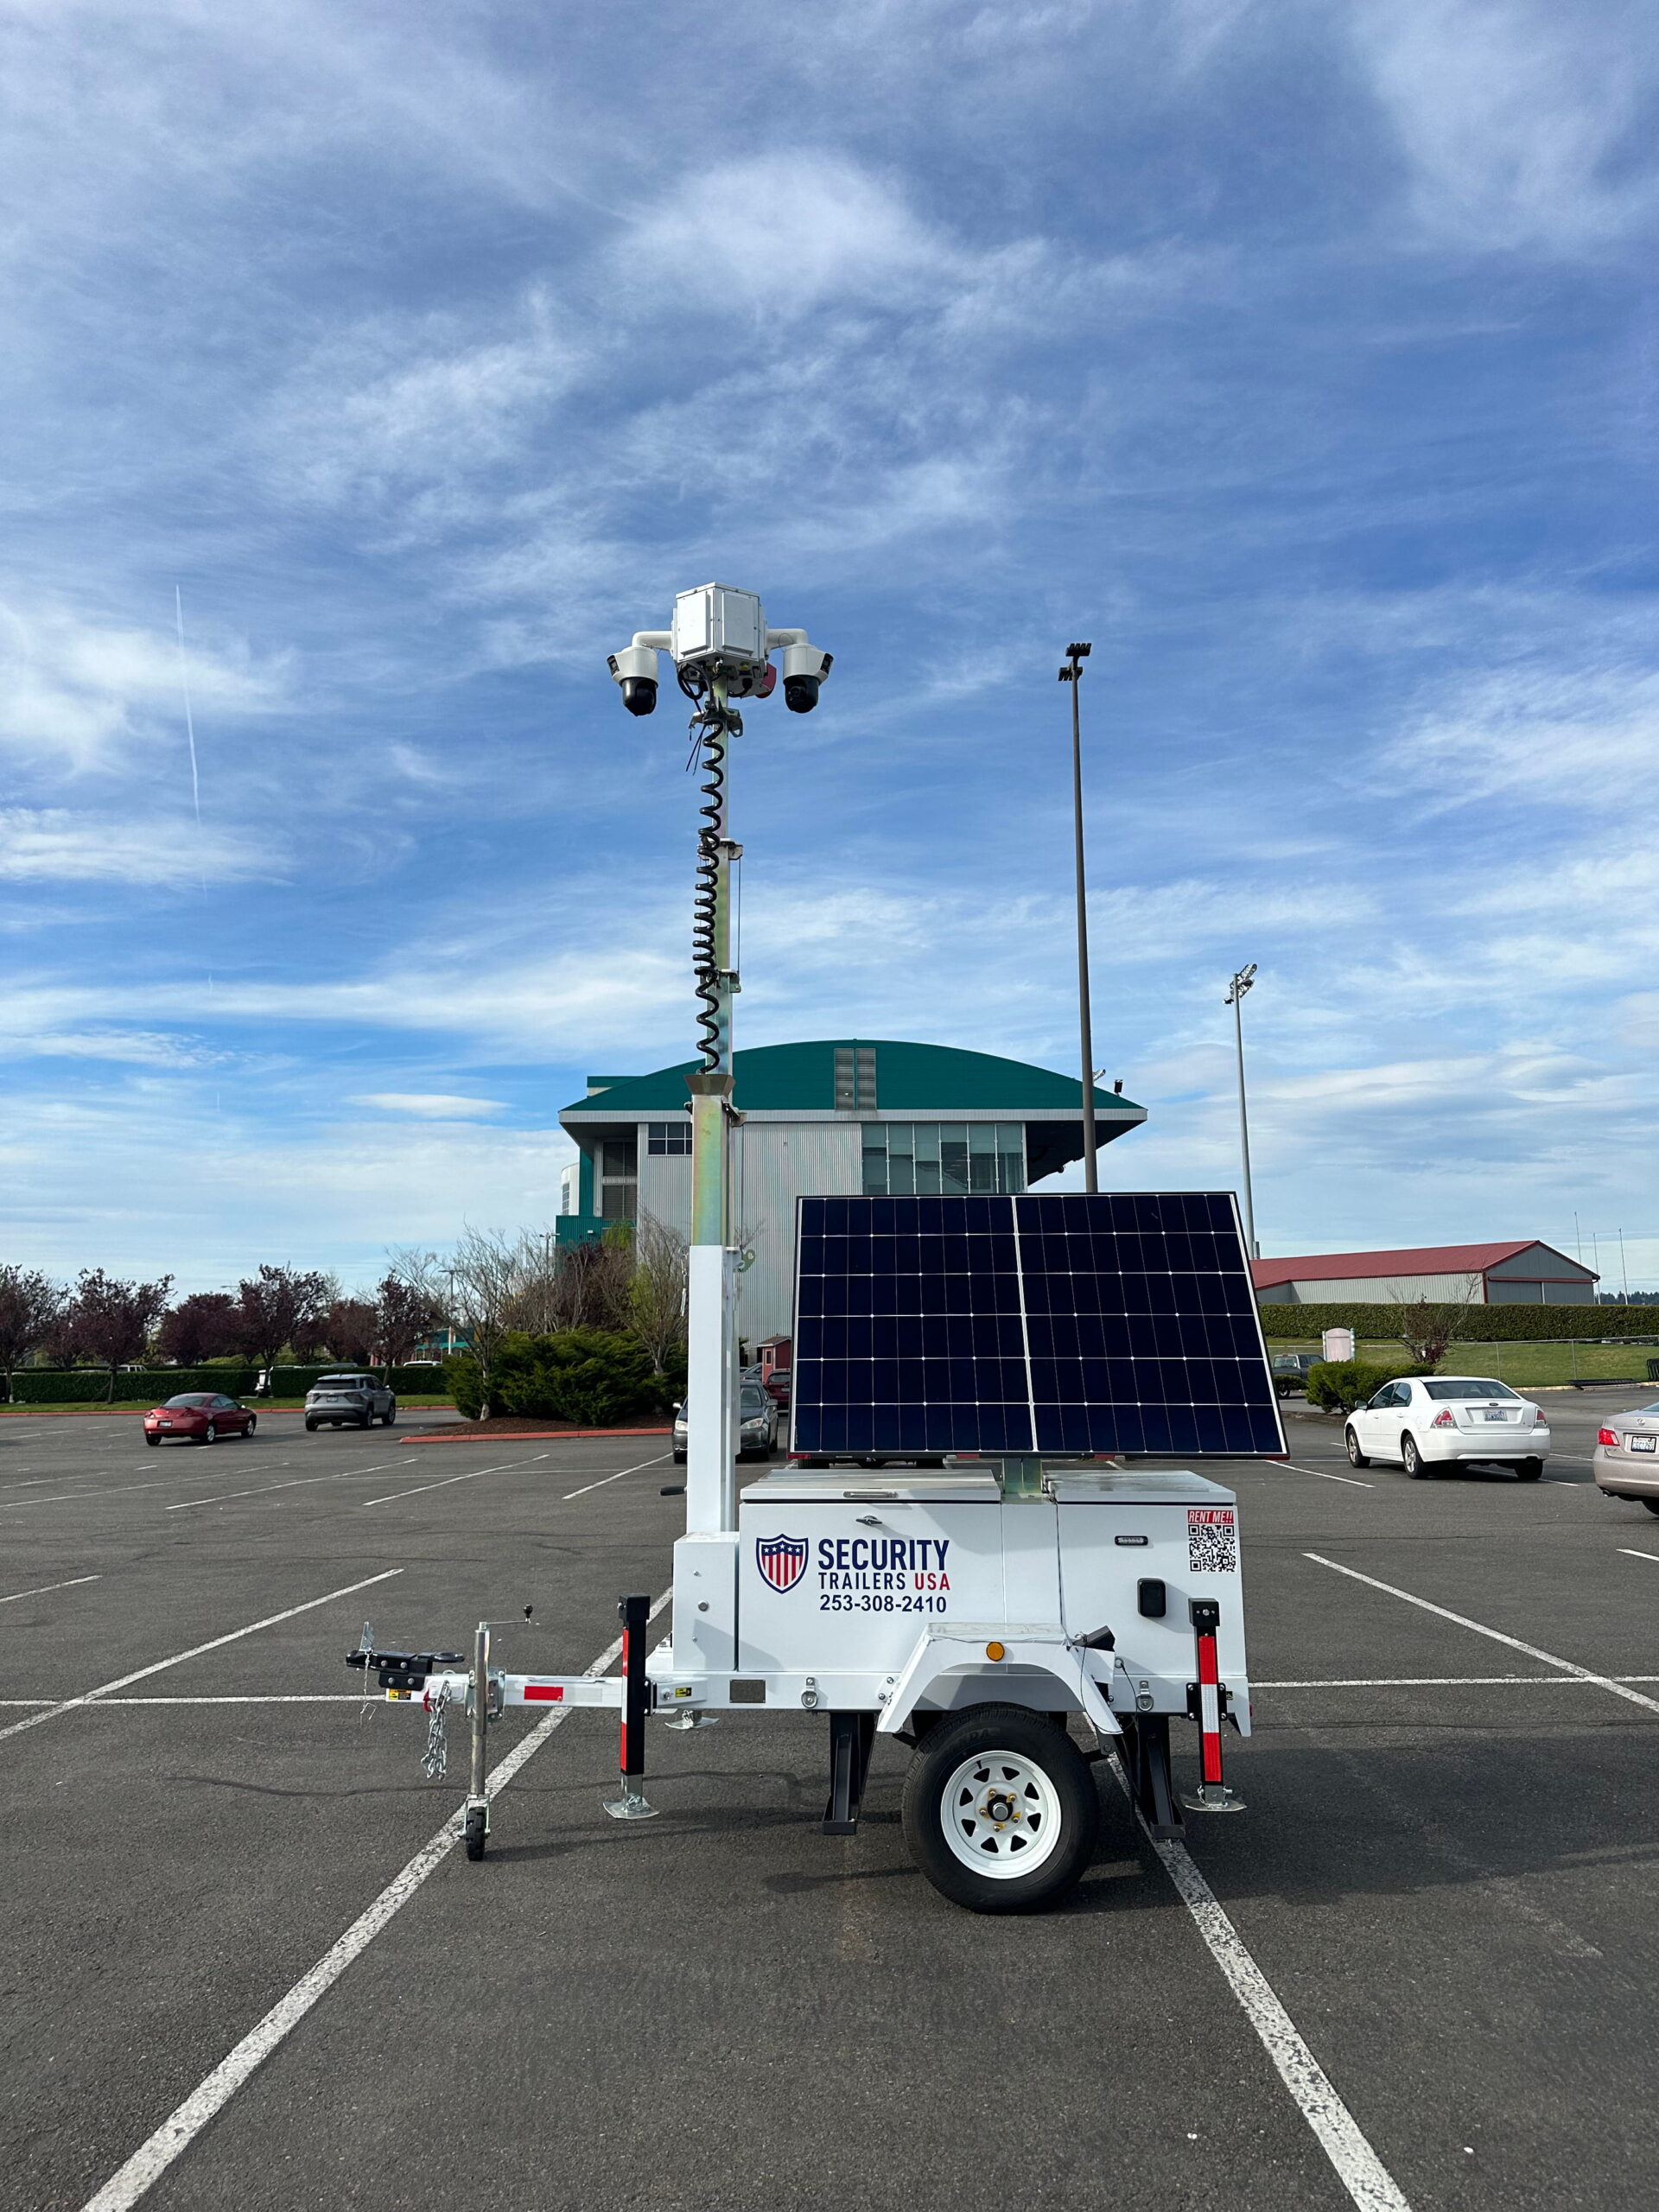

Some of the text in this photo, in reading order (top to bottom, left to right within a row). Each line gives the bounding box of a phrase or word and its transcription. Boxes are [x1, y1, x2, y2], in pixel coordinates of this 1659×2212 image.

[1188, 1510, 1233, 1523] RENT ME!!
[817, 1538, 950, 1571] SECURITY
[817, 1572, 950, 1591] TRAILERS USA
[819, 1593, 947, 1613] 253-308-2410
